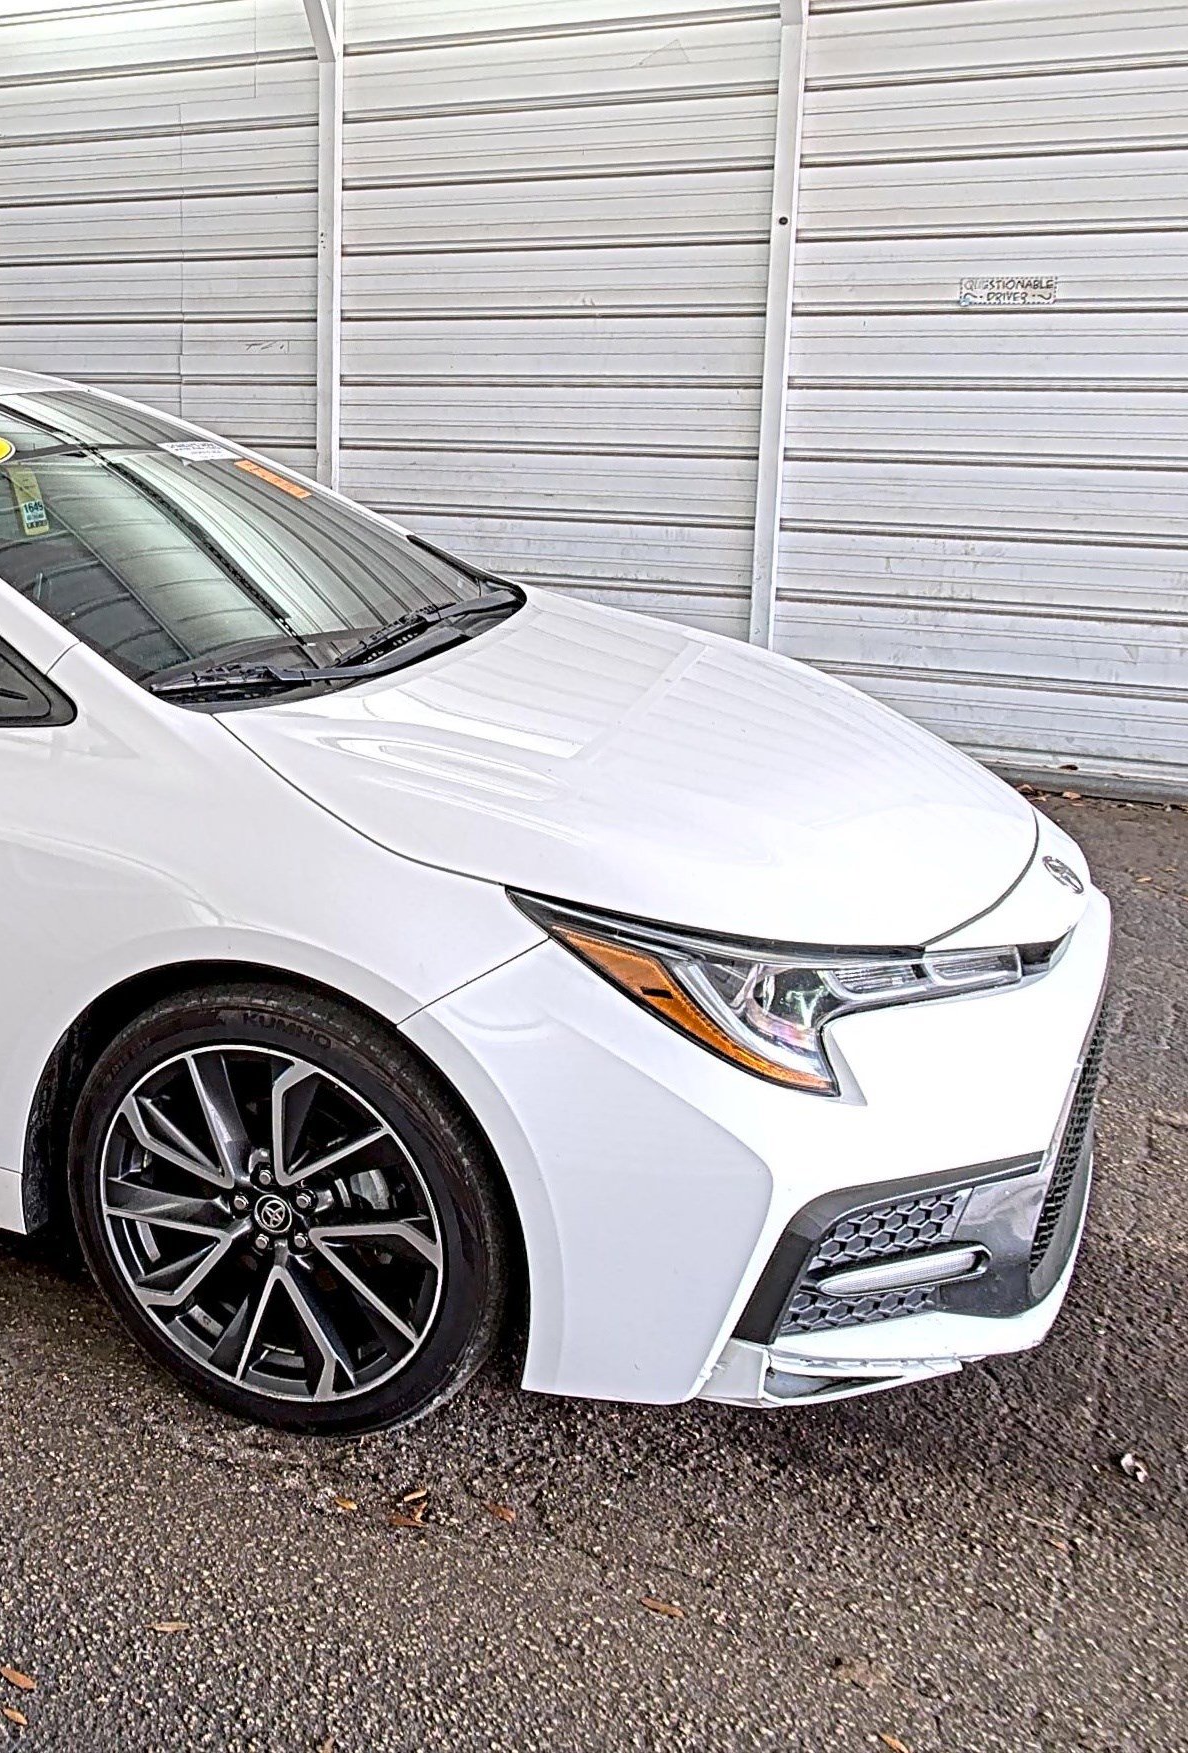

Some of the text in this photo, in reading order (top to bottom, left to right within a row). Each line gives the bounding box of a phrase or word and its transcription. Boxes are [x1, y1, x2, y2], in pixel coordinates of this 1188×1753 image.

[964, 280, 1053, 290] QUESTIONABLE
[986, 292, 1028, 301] DRIVER
[242, 1011, 332, 1049] KUMHO
